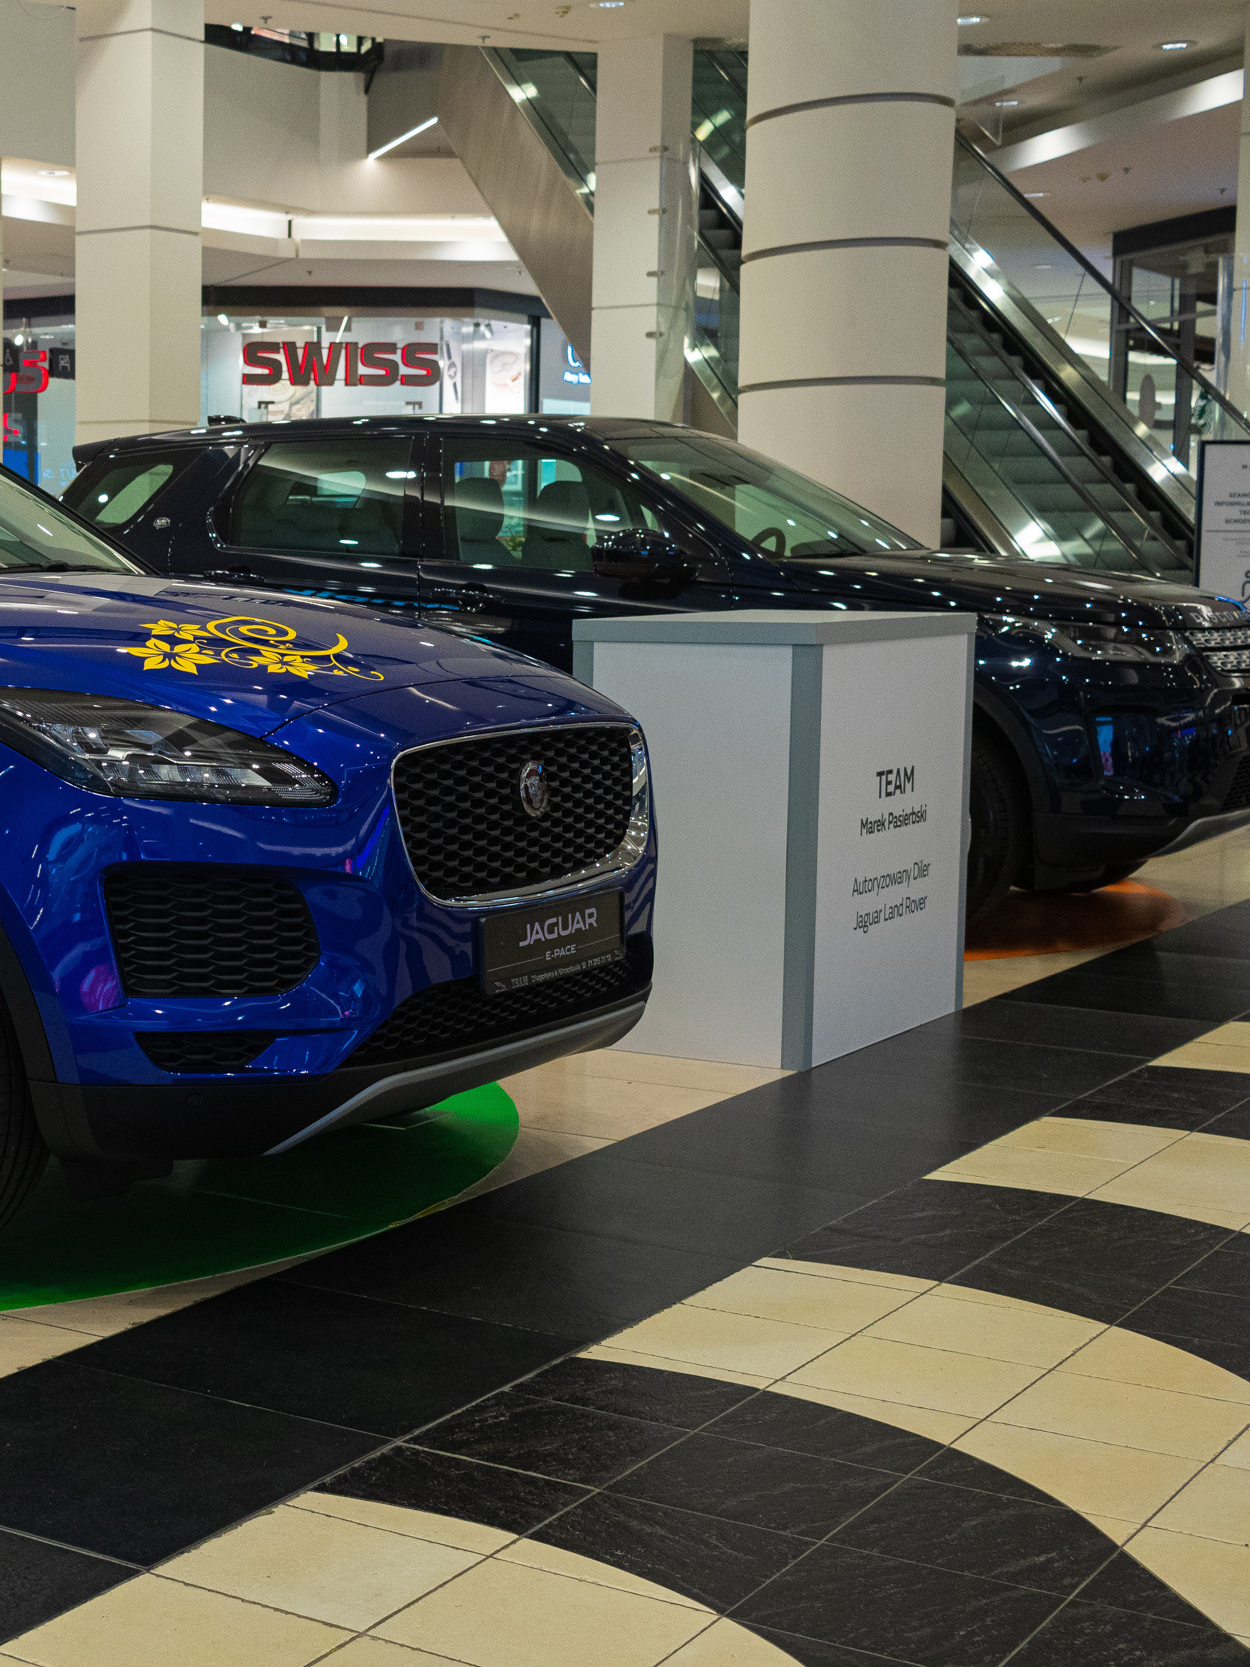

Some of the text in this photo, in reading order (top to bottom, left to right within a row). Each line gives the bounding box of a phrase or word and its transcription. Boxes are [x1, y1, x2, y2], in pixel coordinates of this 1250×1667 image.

[243, 341, 441, 387] SWISS
[876, 765, 915, 799] TEAM
[860, 803, 928, 837] Marek Pasierbski
[852, 859, 931, 897] Autoryzowany Diler
[519, 907, 598, 947] JAGUAR
[853, 895, 928, 934] Jaguar Land Rover
[545, 944, 577, 961] E-PACE
